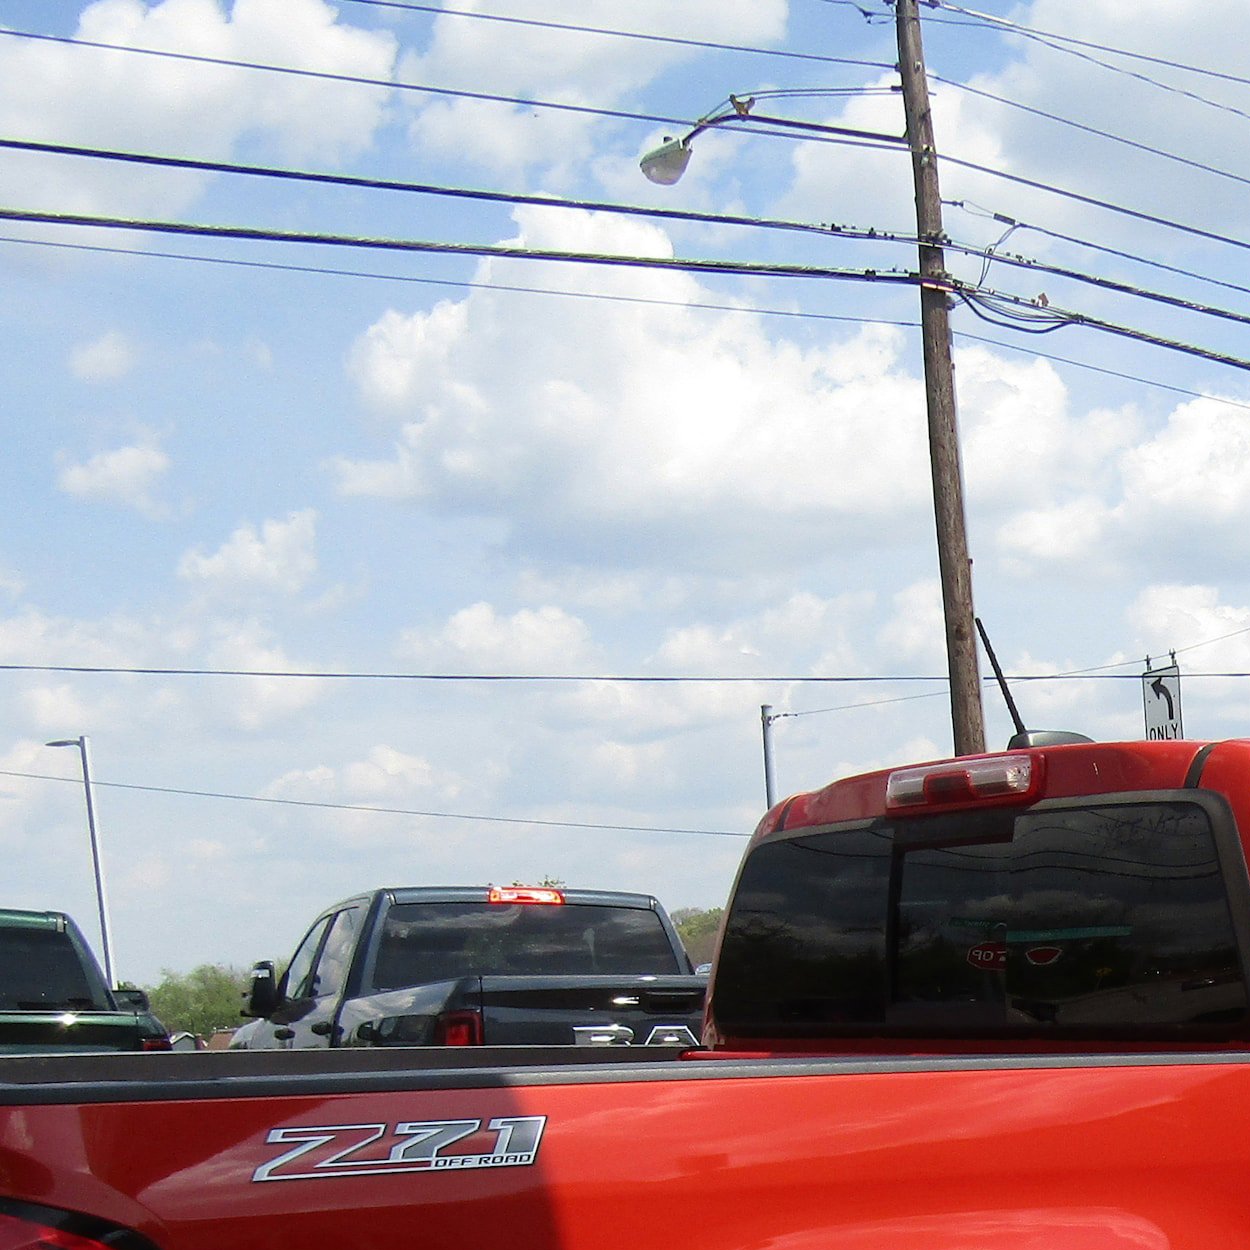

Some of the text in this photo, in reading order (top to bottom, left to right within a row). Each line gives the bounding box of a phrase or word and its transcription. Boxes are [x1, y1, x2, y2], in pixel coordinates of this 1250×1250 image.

[1149, 723, 1178, 740] ONLY
[572, 1024, 701, 1046] RA
[252, 1115, 547, 1182] Z71
[434, 1153, 532, 1168] OFF ROAD
